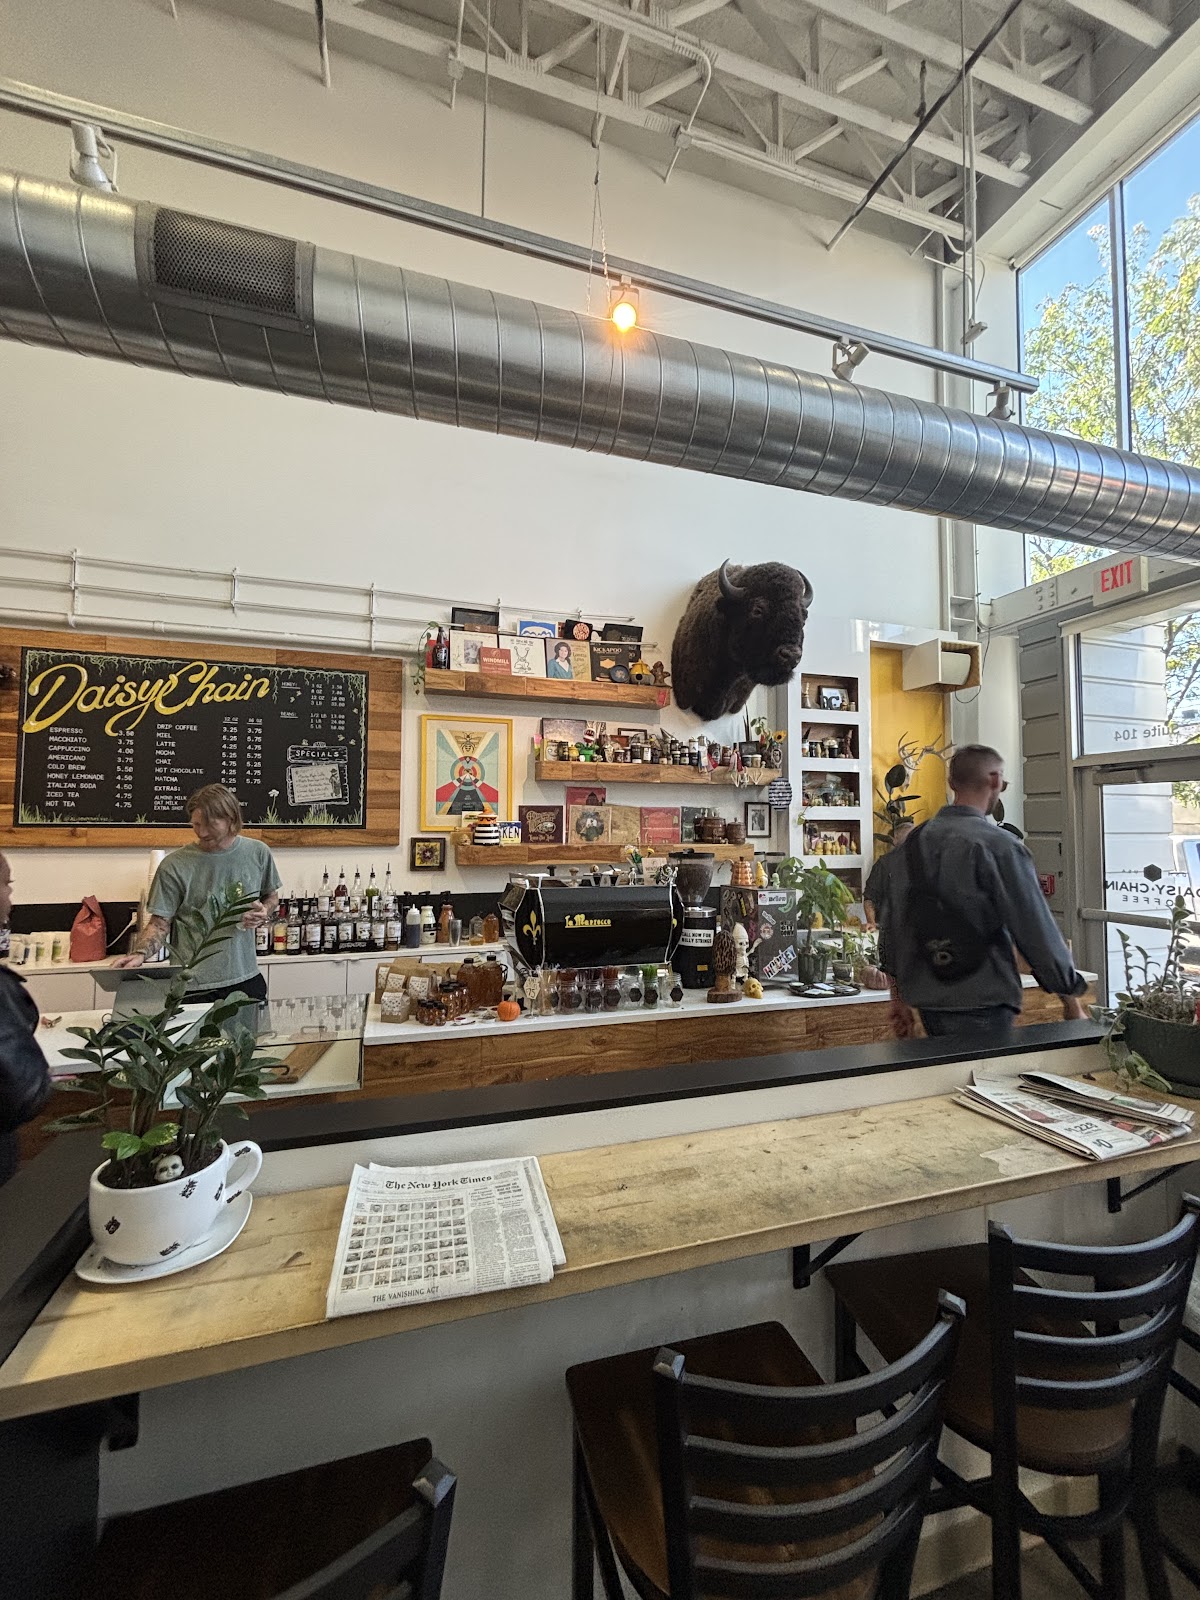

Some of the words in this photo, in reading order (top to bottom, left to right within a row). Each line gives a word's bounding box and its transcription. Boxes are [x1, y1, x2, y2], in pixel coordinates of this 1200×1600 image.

[1102, 560, 1133, 592] EXIT
[22, 663, 165, 736] Daisy
[154, 661, 270, 714] Chain
[296, 750, 339, 758] SPECIALS
[386, 1181, 406, 1190] The
[407, 1181, 430, 1190] New
[433, 1179, 458, 1189] York
[460, 1176, 491, 1184] Times
[373, 1294, 386, 1303] THE
[388, 1289, 424, 1299] VANISHING
[427, 1286, 439, 1294] ACT
